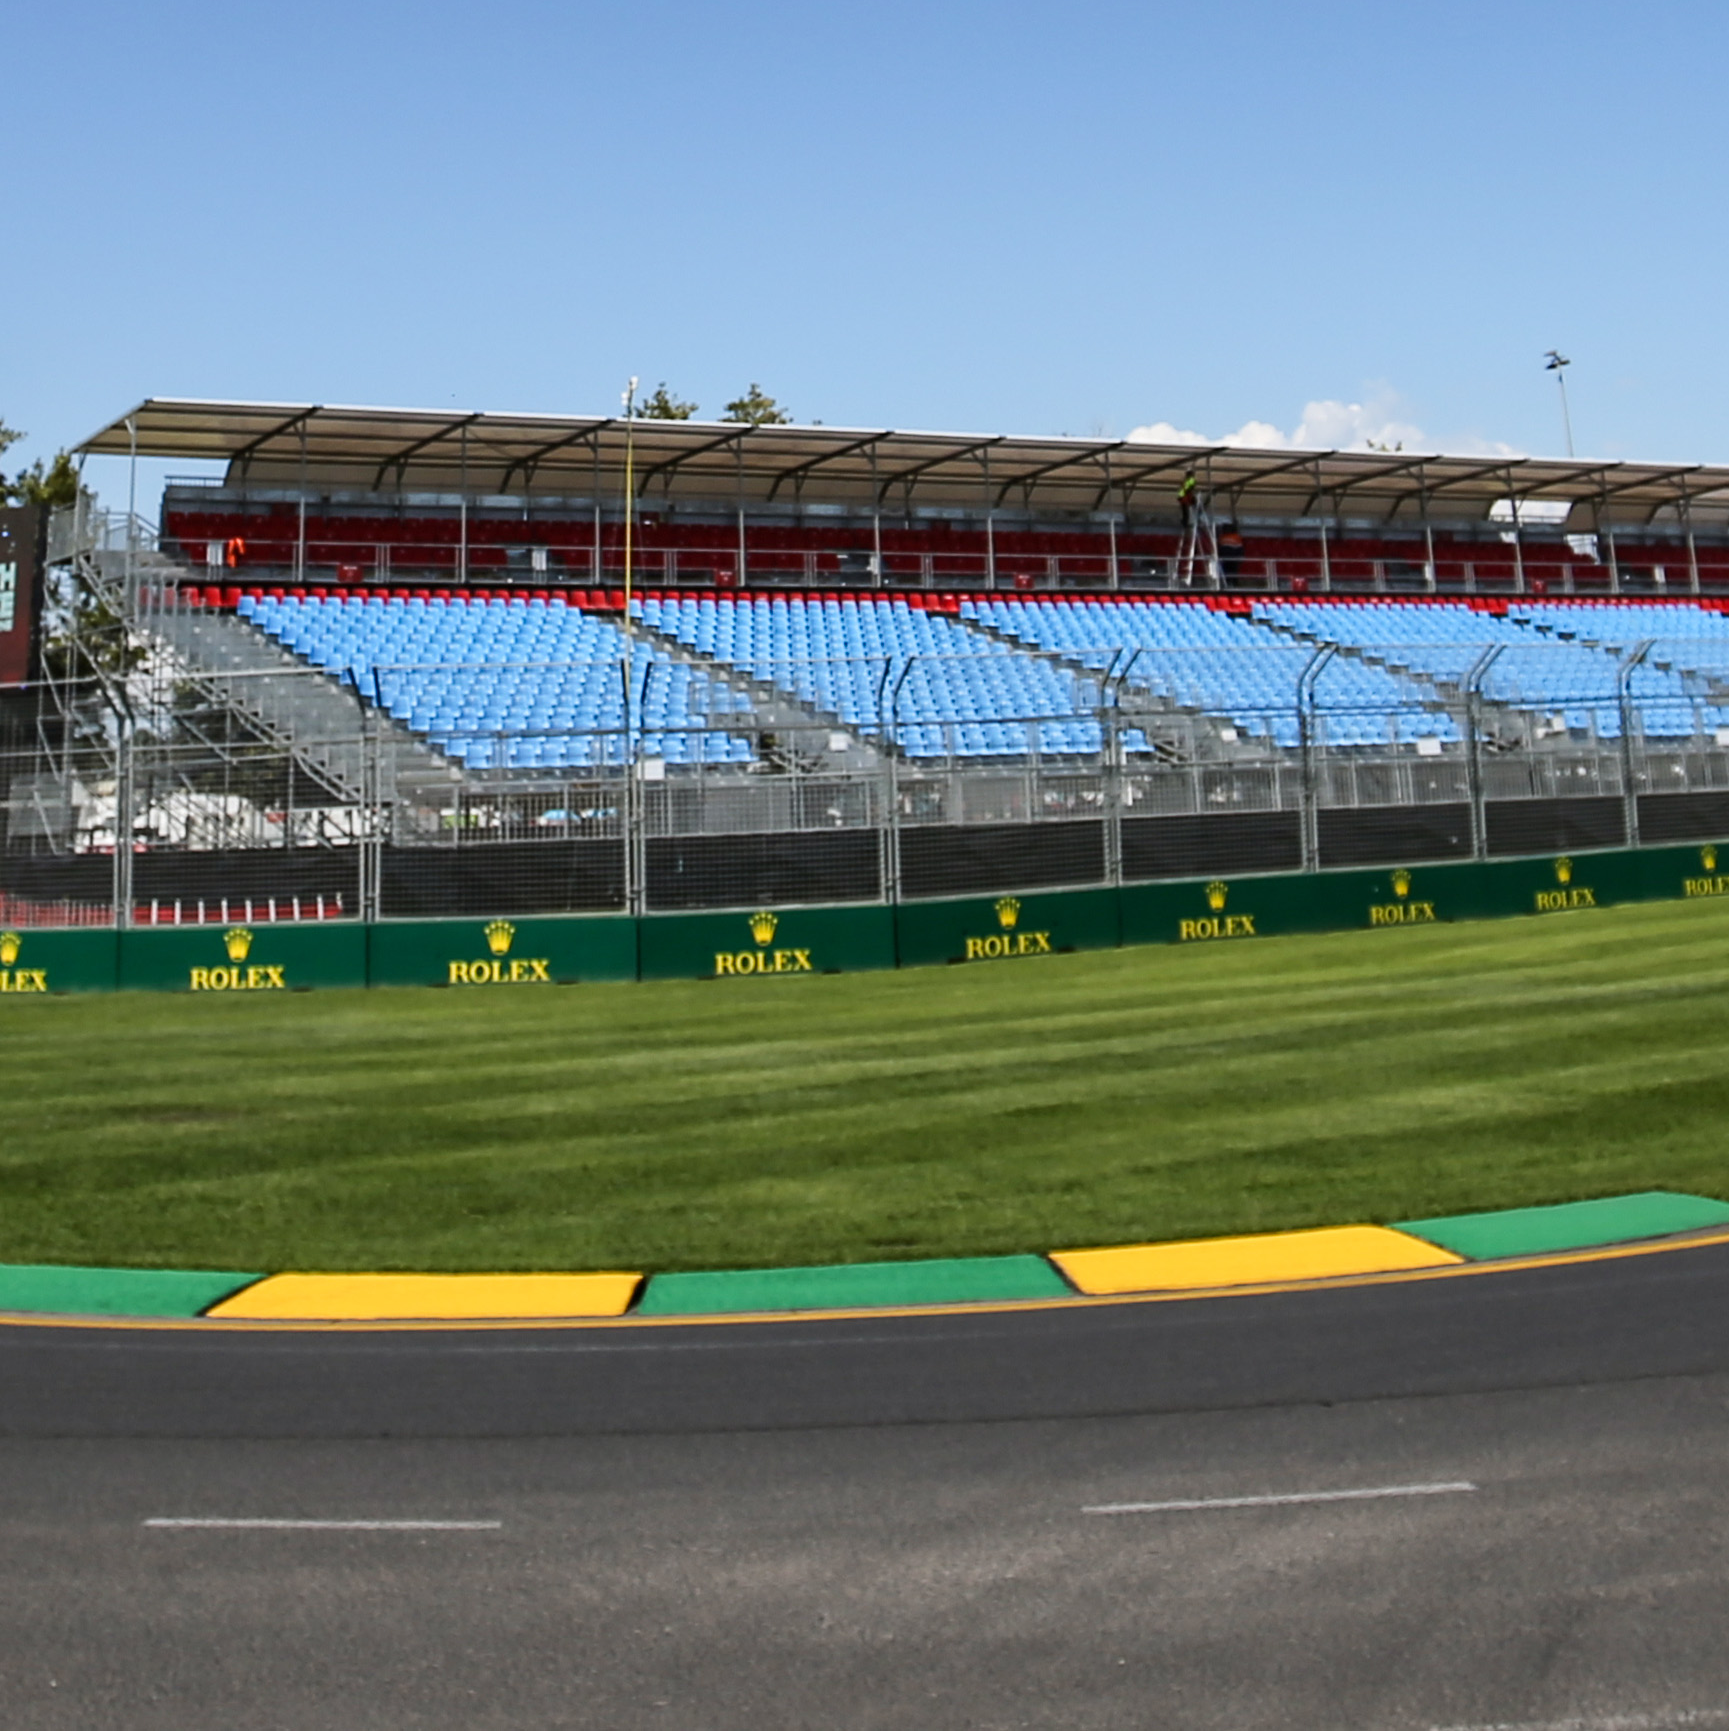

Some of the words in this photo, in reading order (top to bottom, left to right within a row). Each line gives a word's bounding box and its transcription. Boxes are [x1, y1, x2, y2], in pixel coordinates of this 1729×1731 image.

[1536, 889, 1596, 911] ROLEX
[1370, 902, 1435, 925] ROLEX
[1180, 915, 1256, 941] ROLEX
[966, 931, 1052, 960] ROLEX
[449, 959, 551, 984] ROLEX
[715, 949, 813, 975] ROLEX
[190, 965, 286, 990] ROLEX
